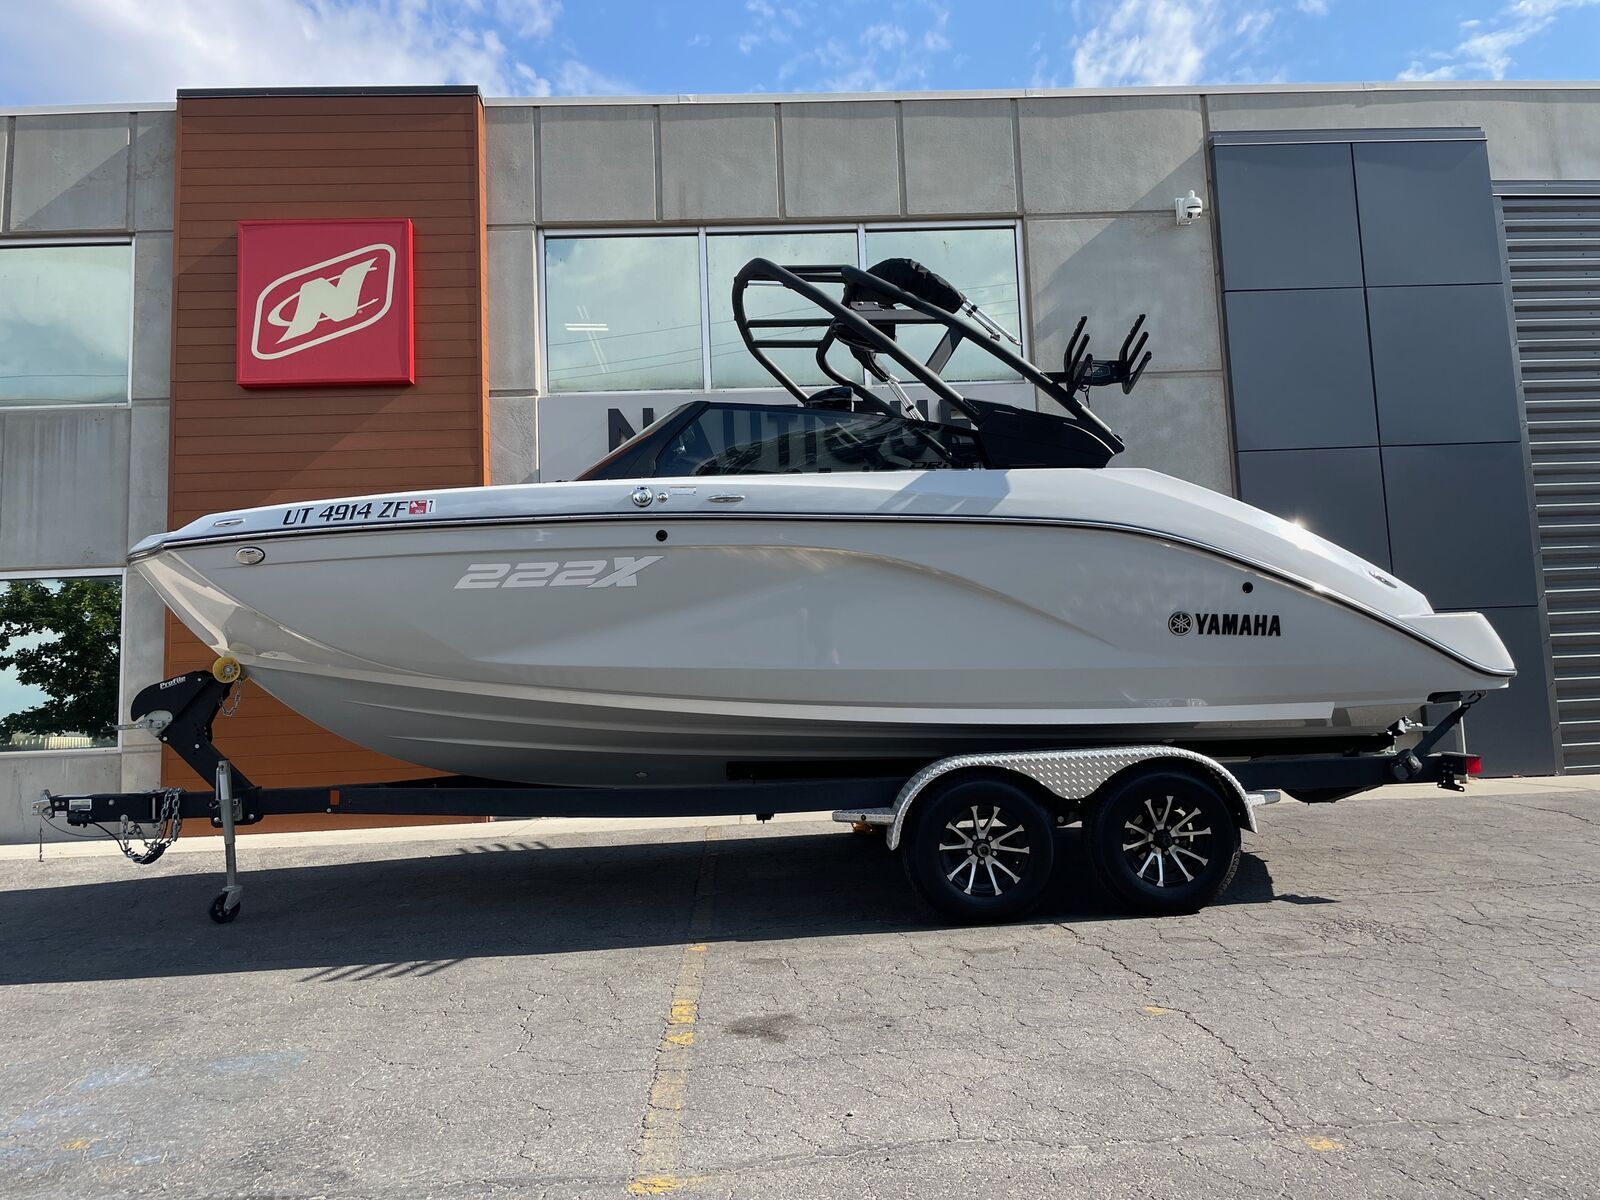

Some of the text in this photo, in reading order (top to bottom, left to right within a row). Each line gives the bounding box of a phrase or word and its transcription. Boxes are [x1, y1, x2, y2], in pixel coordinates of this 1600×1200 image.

[282, 501, 409, 525] UT 4914 ZF
[454, 555, 665, 589] 222X
[1195, 613, 1281, 637] YAMAHA
[159, 675, 187, 690] Profile
